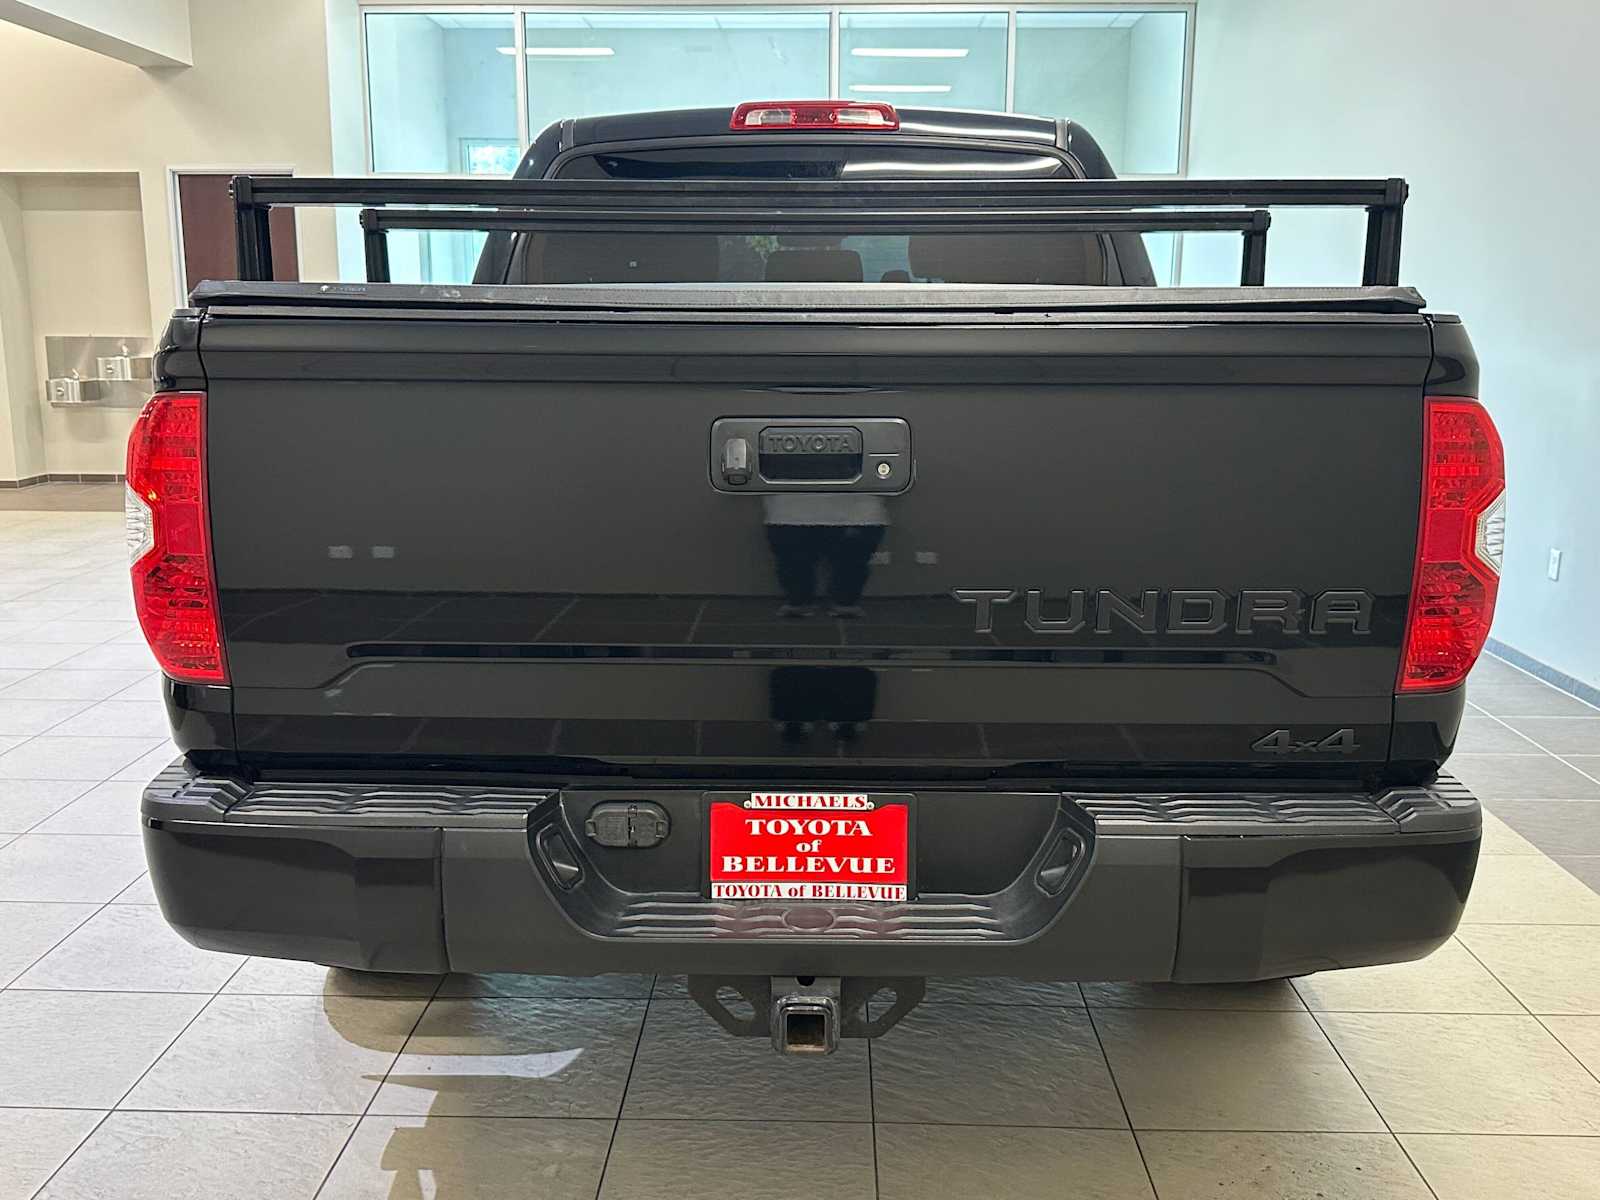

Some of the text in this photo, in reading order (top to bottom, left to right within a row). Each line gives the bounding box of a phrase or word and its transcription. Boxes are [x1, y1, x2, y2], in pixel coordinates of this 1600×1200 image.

[768, 434, 853, 452] TOYOTA
[952, 587, 1374, 635] TUNDRA
[1251, 728, 1358, 754] 4x4
[754, 794, 866, 808] MICHAELS
[744, 818, 873, 837] TOYOTA
[795, 839, 822, 853] of
[721, 855, 896, 874] BELLEVUE
[713, 884, 905, 900] TOYOTA of BELLEVUE
